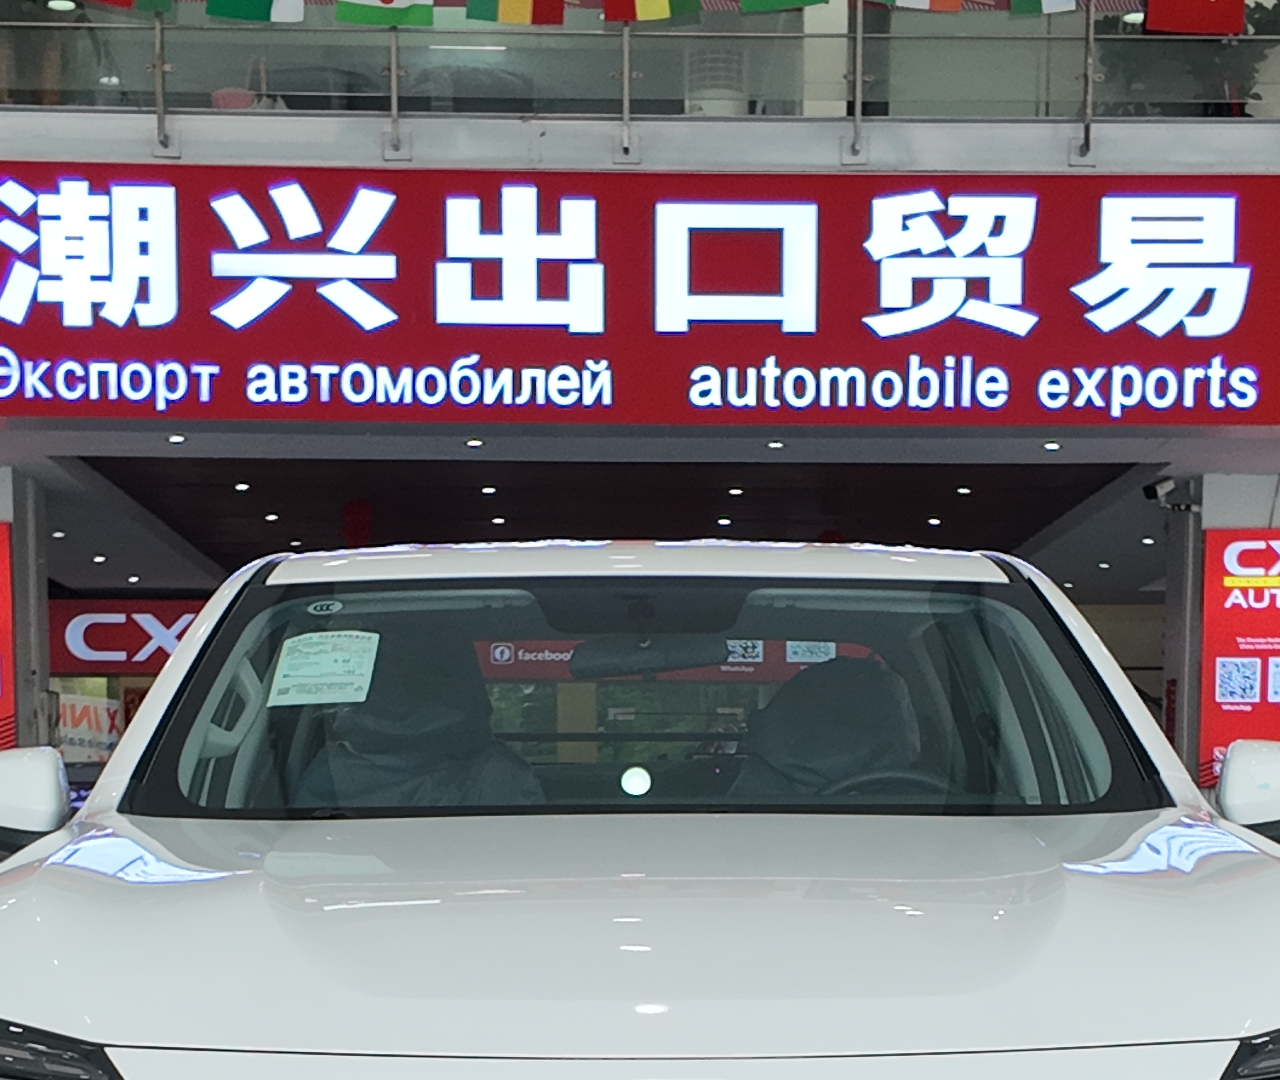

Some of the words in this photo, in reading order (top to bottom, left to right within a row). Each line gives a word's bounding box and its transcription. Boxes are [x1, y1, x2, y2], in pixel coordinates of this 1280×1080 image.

[247, 354, 612, 405] автомобилей
[689, 355, 1009, 408] automobile
[1038, 356, 1257, 417] exports
[65, 613, 197, 662] CX
